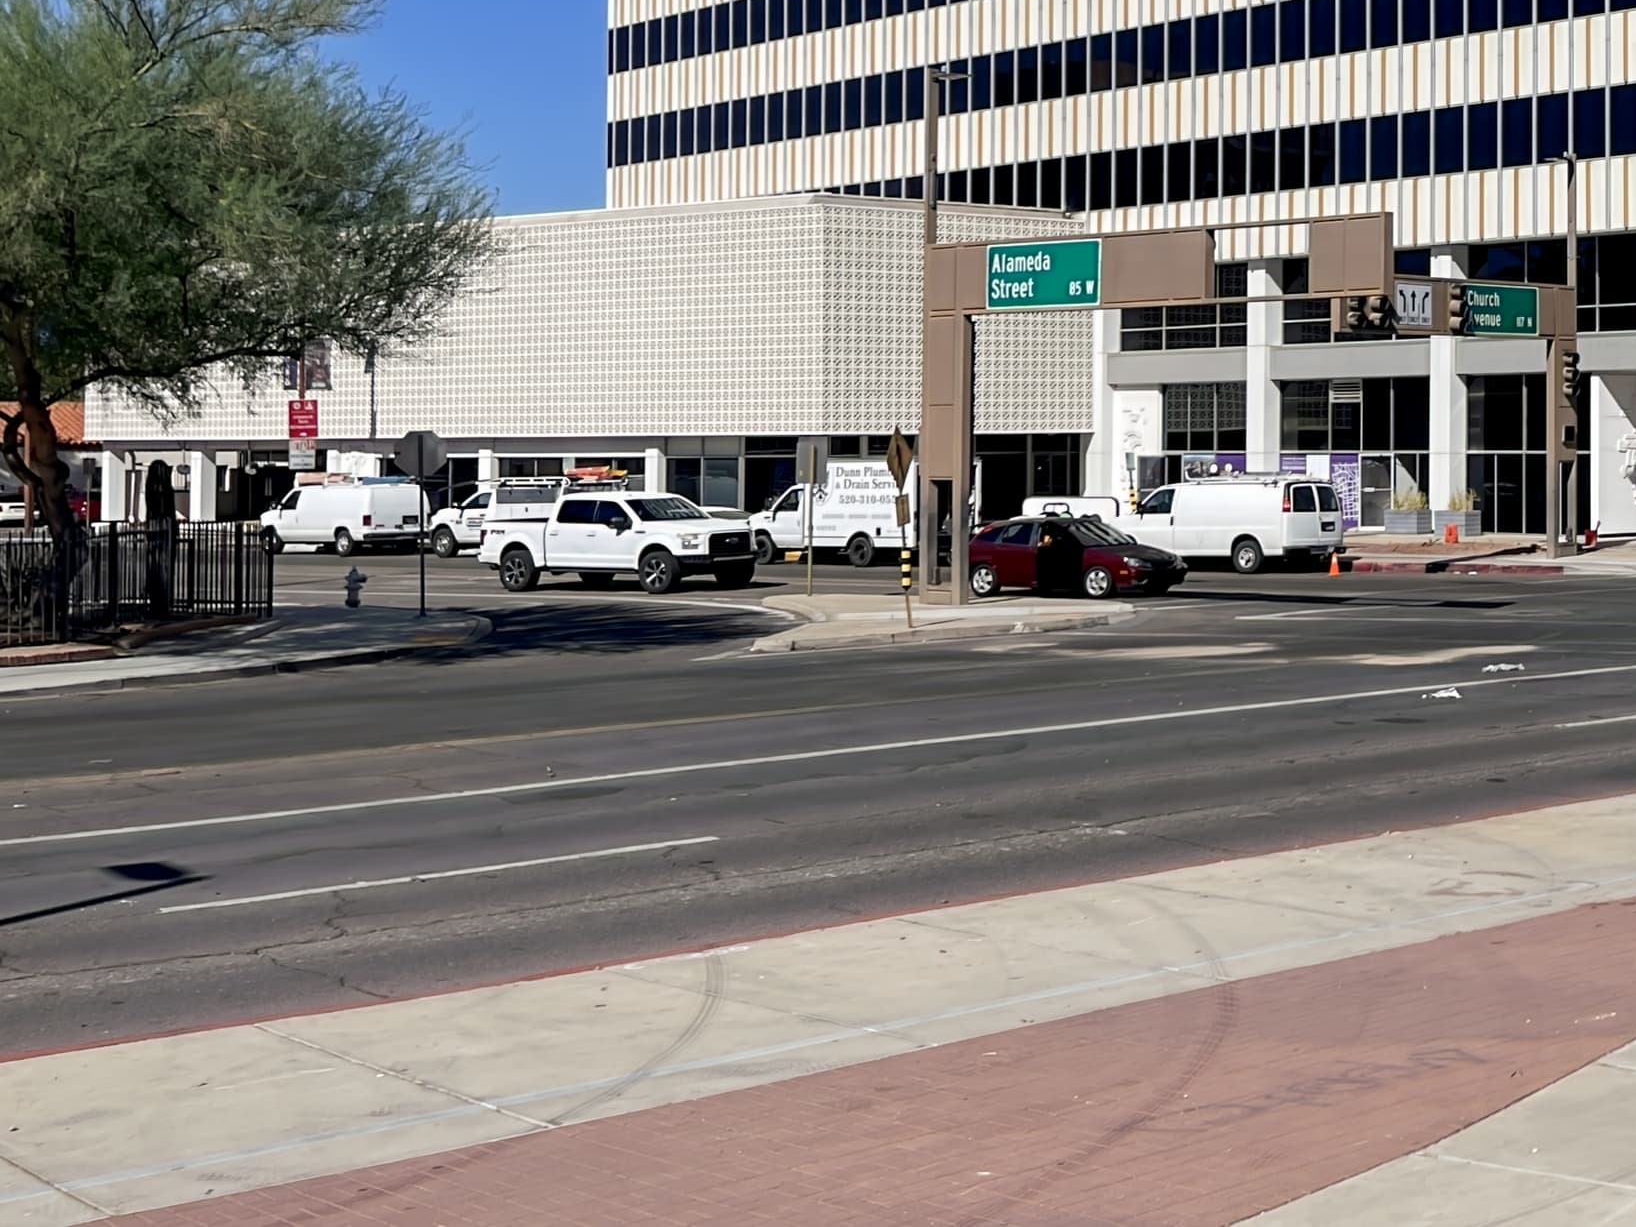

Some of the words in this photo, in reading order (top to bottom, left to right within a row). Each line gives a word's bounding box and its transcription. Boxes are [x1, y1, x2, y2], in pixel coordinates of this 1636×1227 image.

[991, 251, 1051, 273] Alameda
[991, 278, 1034, 299] Street
[1068, 280, 1082, 296] 85
[1085, 279, 1095, 295] W
[1467, 290, 1500, 307] Church
[836, 466, 861, 477] Dunn
[843, 479, 870, 490] Drain
